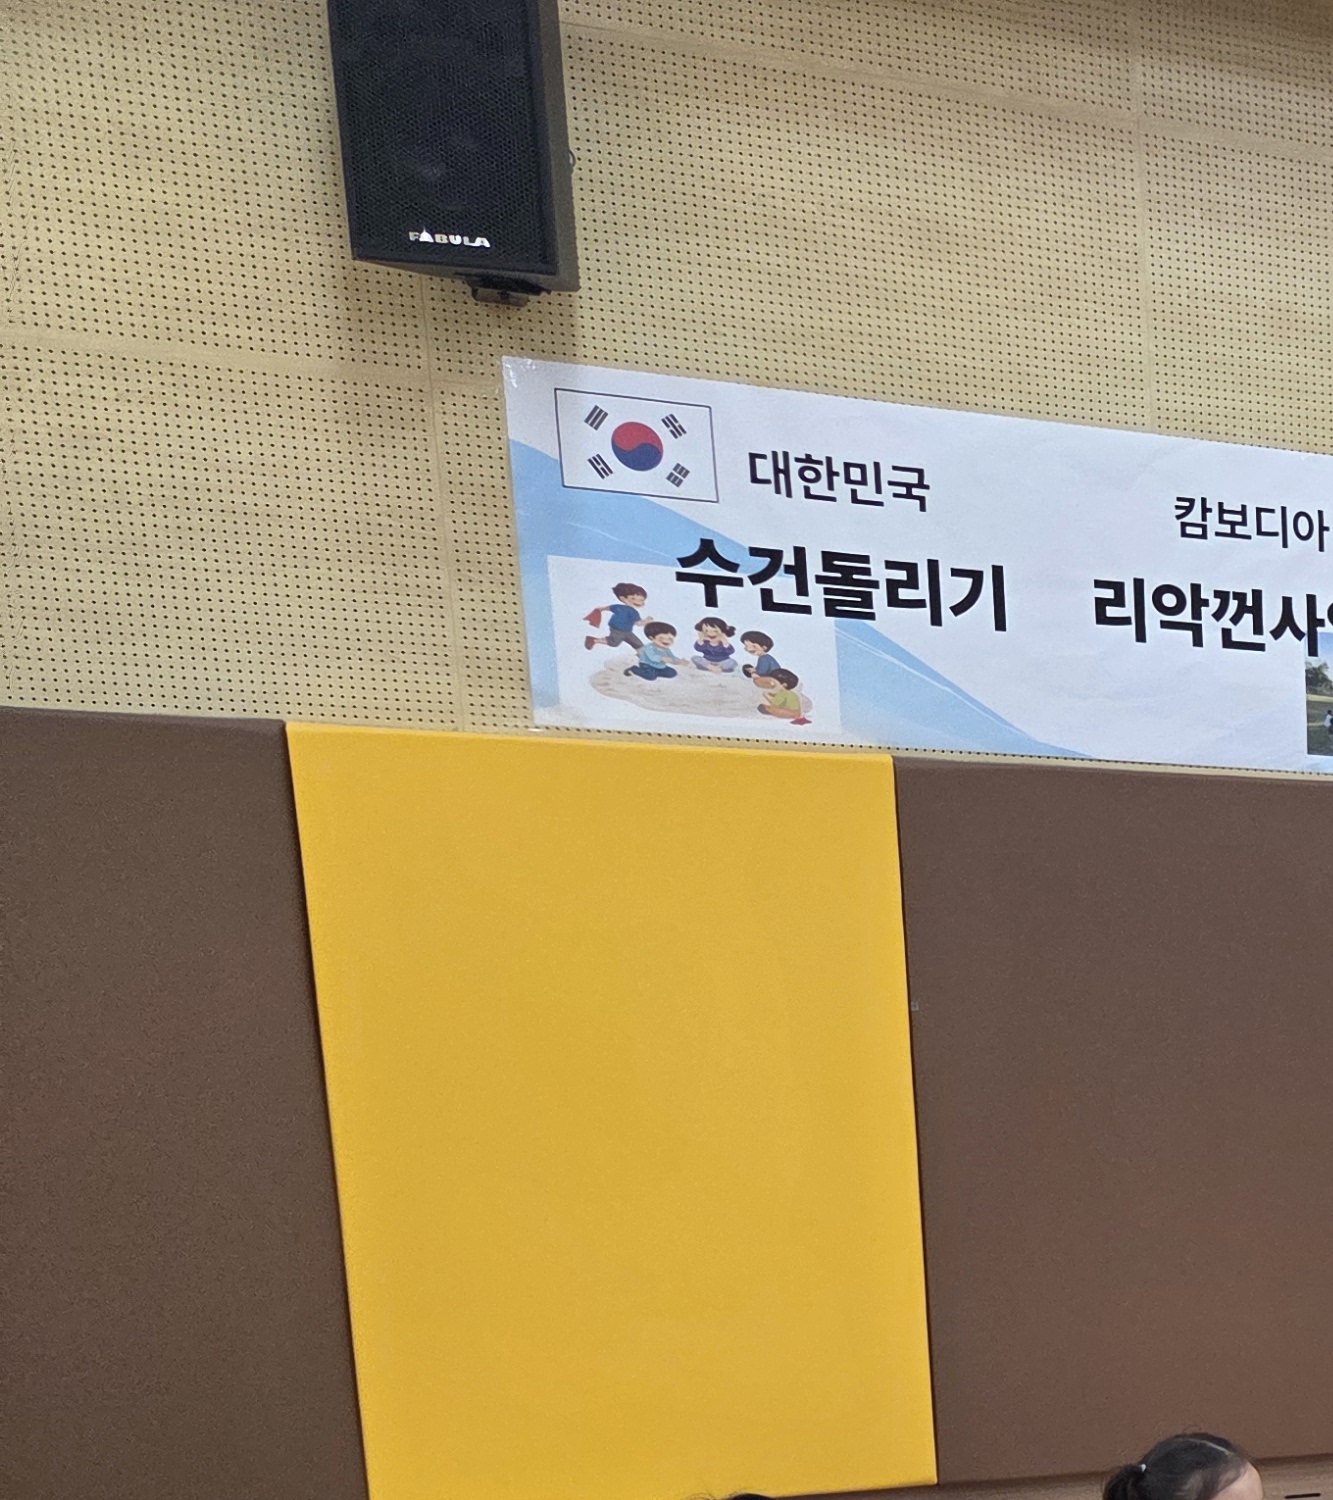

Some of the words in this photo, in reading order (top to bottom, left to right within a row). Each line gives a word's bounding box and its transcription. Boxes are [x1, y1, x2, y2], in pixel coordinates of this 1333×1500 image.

[748, 450, 930, 512] 대한민국
[1174, 496, 1330, 552] 캄보디아
[675, 538, 1007, 632] 수건돌리기
